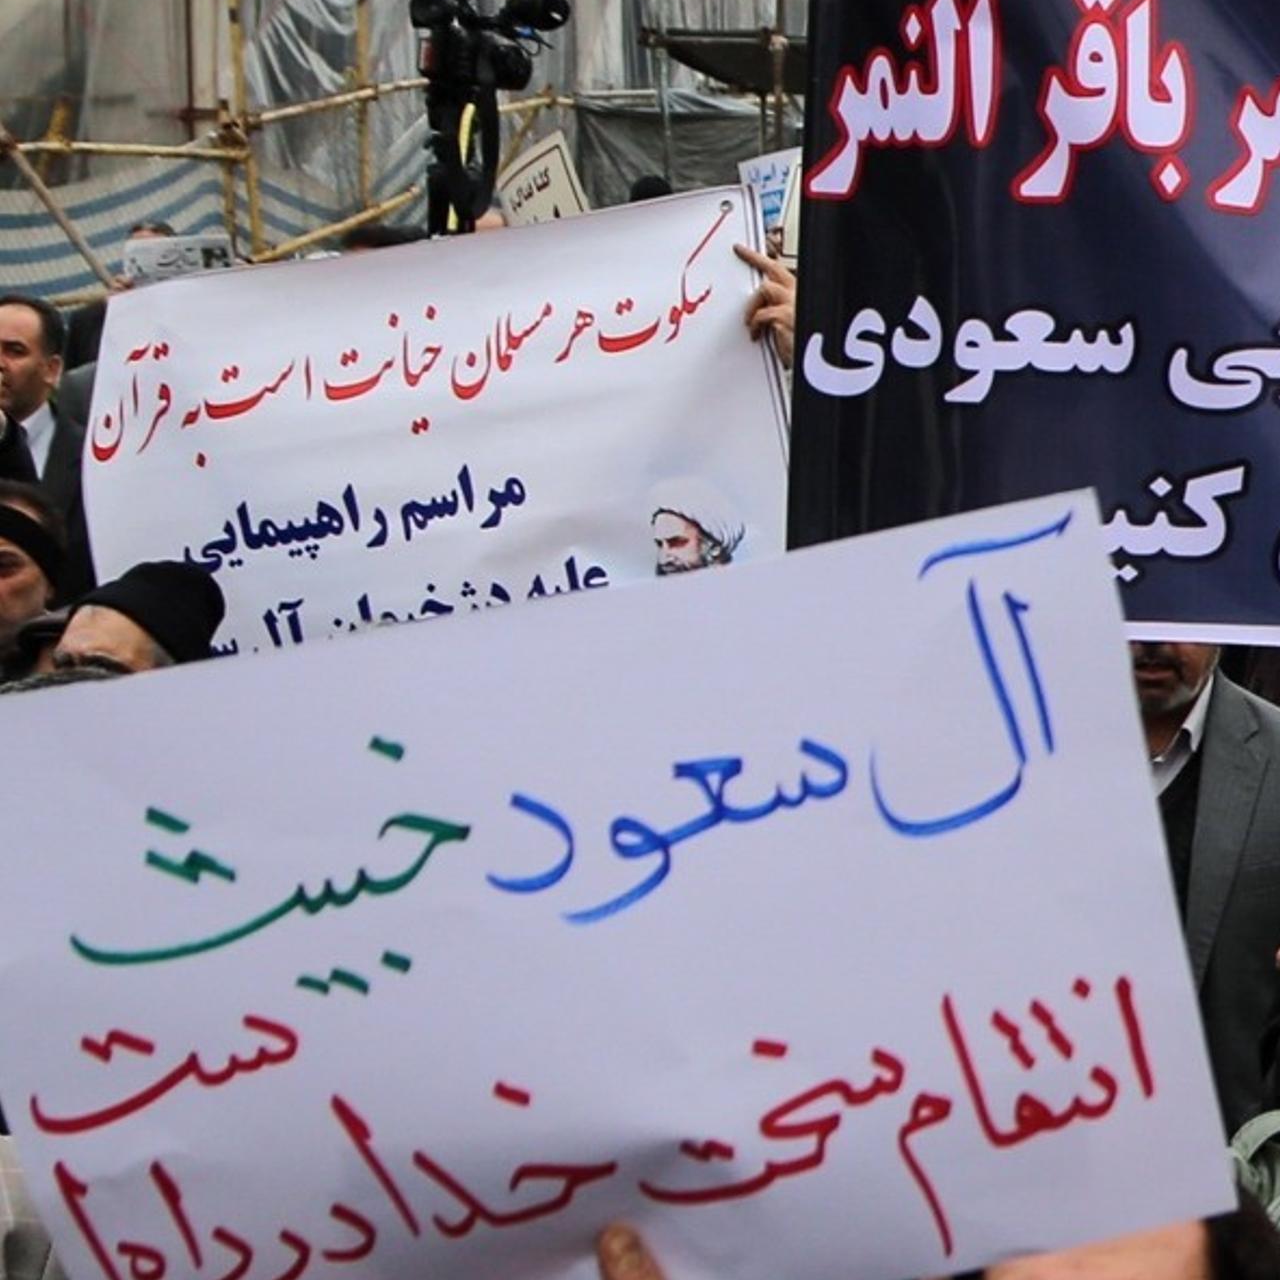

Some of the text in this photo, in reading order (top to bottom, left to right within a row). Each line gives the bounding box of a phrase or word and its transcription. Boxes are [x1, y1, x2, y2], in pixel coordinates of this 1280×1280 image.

[554, 309, 595, 365] هر
[597, 208, 731, 353] سکوت
[91, 341, 172, 463] قرآن
[203, 353, 312, 421] است
[323, 304, 443, 435] خیانت
[450, 301, 554, 401] مسلمان
[799, 291, 1138, 407] سعودی
[399, 461, 527, 543] مراسم
[69, 510, 1077, 997] آل سعود خبیث
[637, 1035, 907, 1208] سخت
[894, 975, 1159, 1258] انتقام
